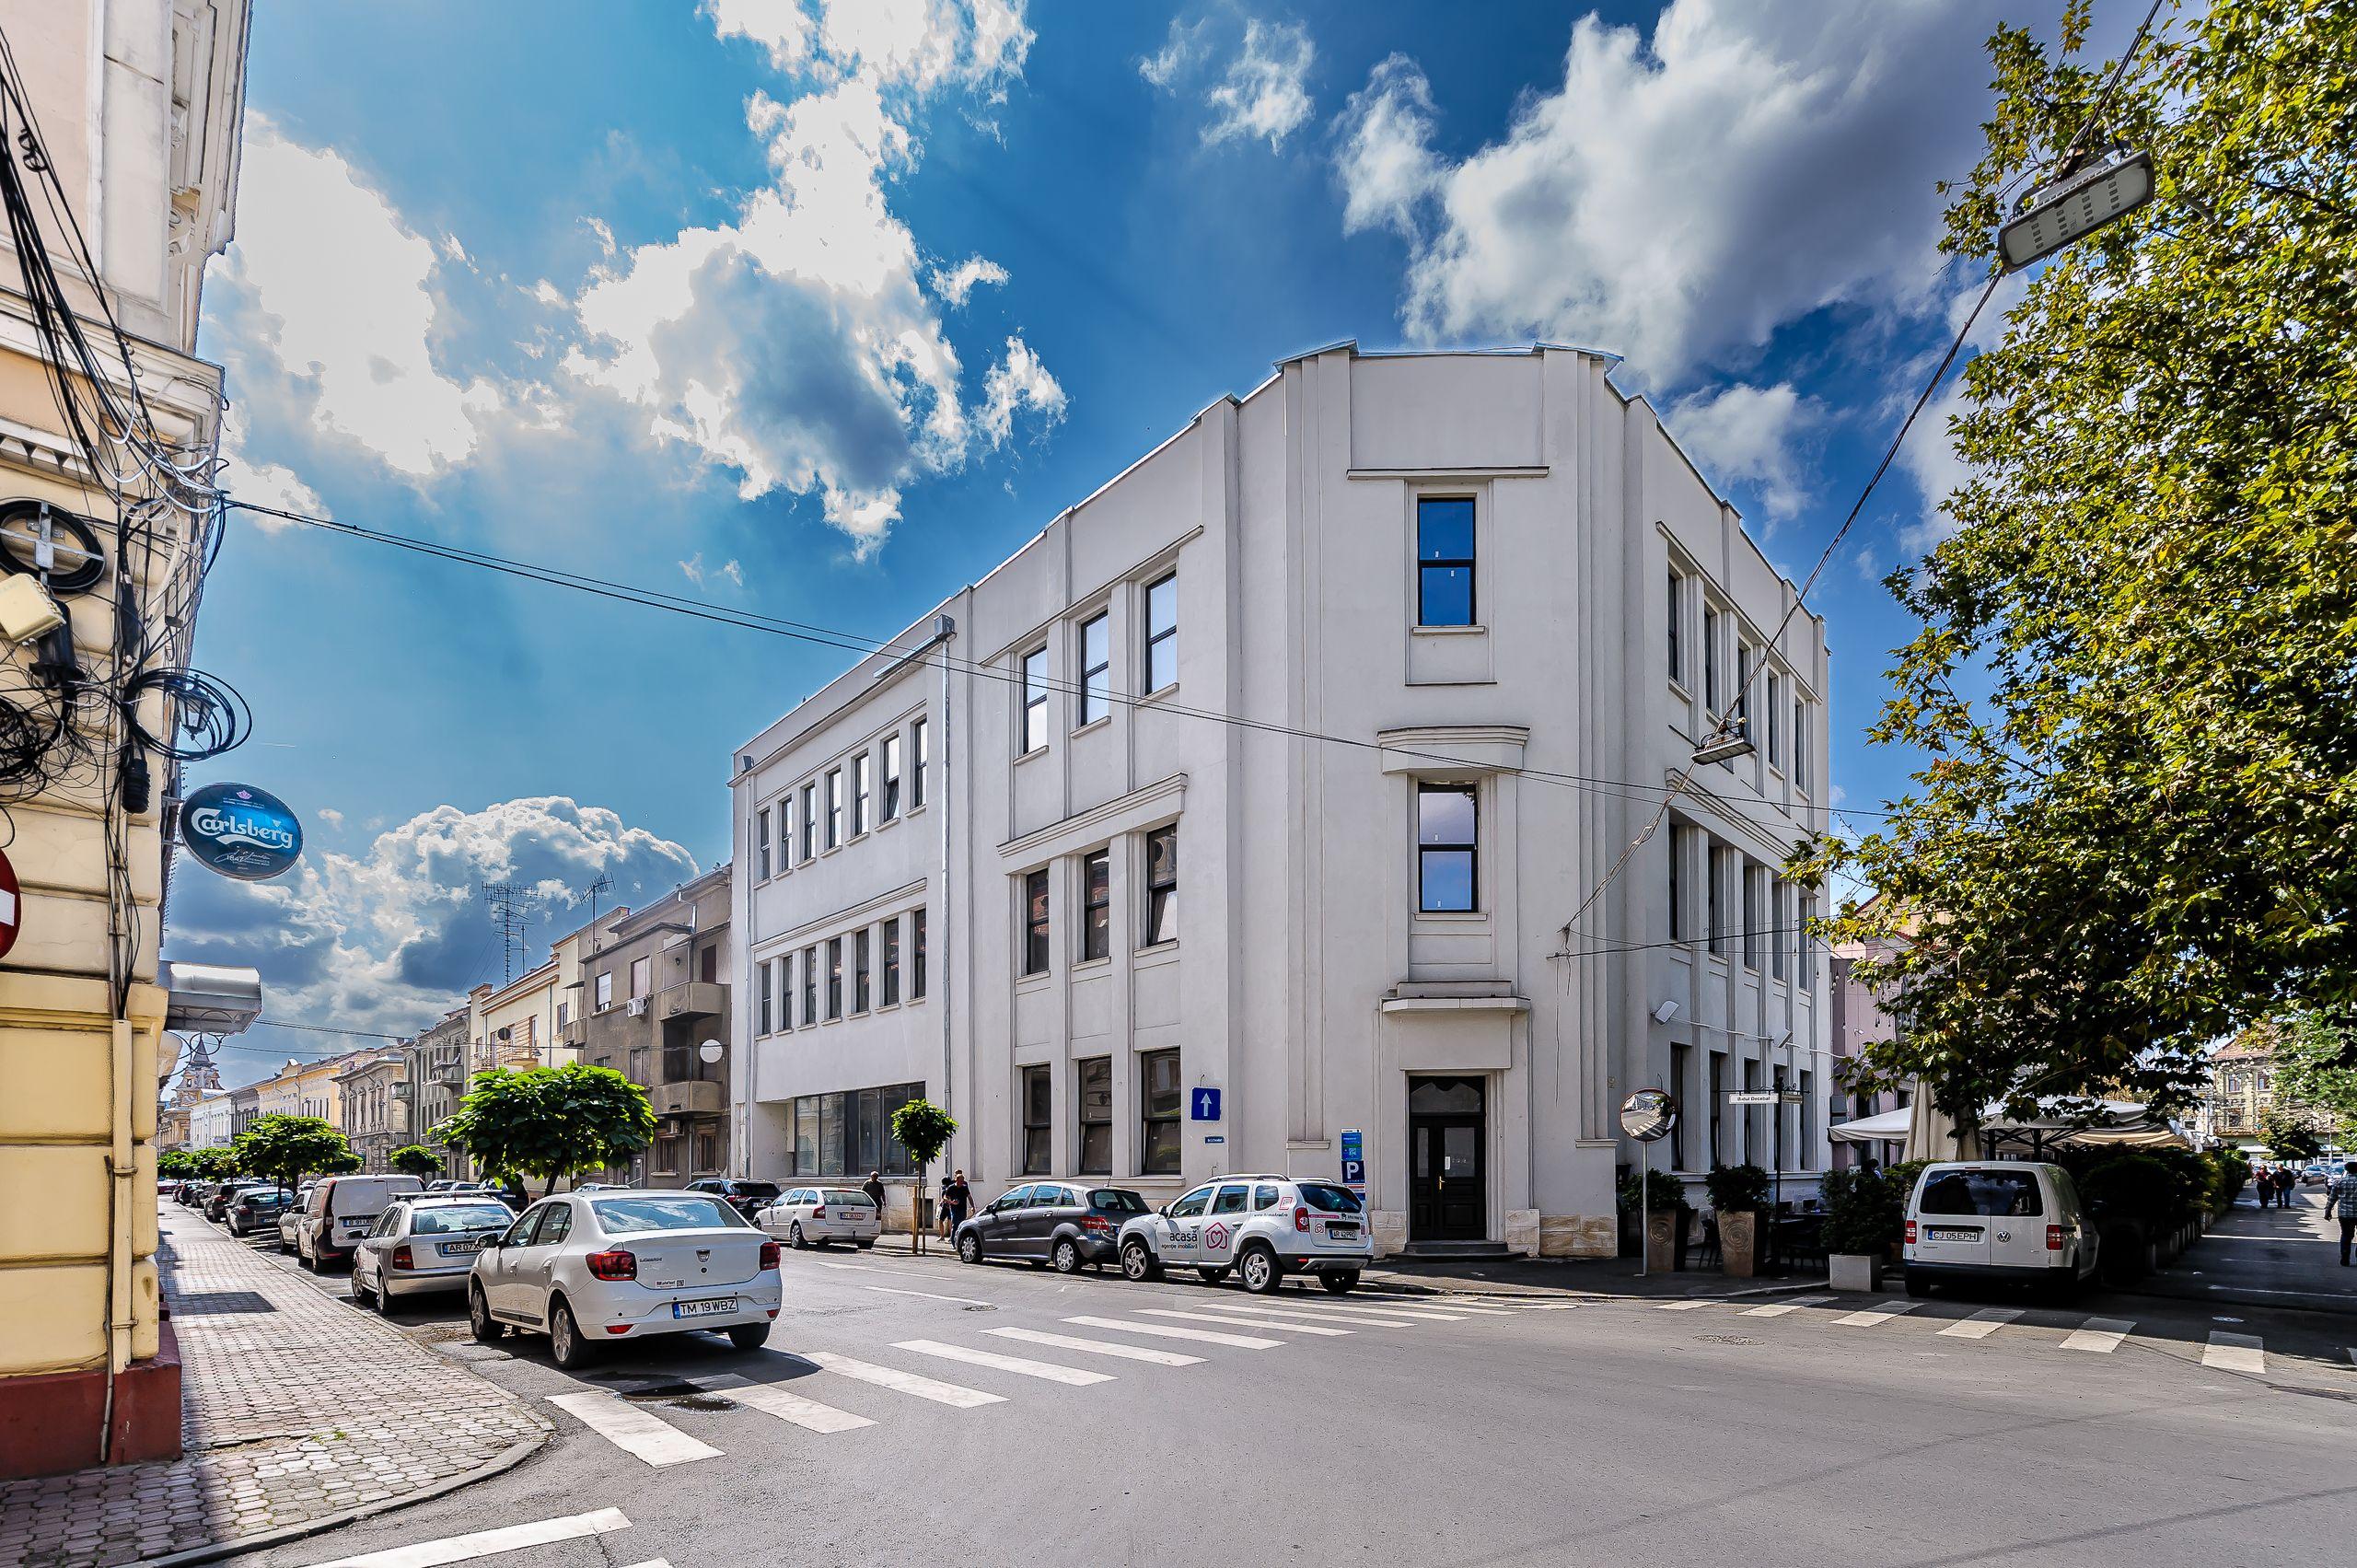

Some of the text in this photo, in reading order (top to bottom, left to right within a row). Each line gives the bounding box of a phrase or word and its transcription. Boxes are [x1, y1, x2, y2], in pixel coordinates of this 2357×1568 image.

[192, 807, 293, 849] Carlsberg
[1346, 1161, 1360, 1179] P
[1169, 1229, 1198, 1242] acasă
[449, 1244, 462, 1252] AR
[680, 1304, 697, 1315] TM
